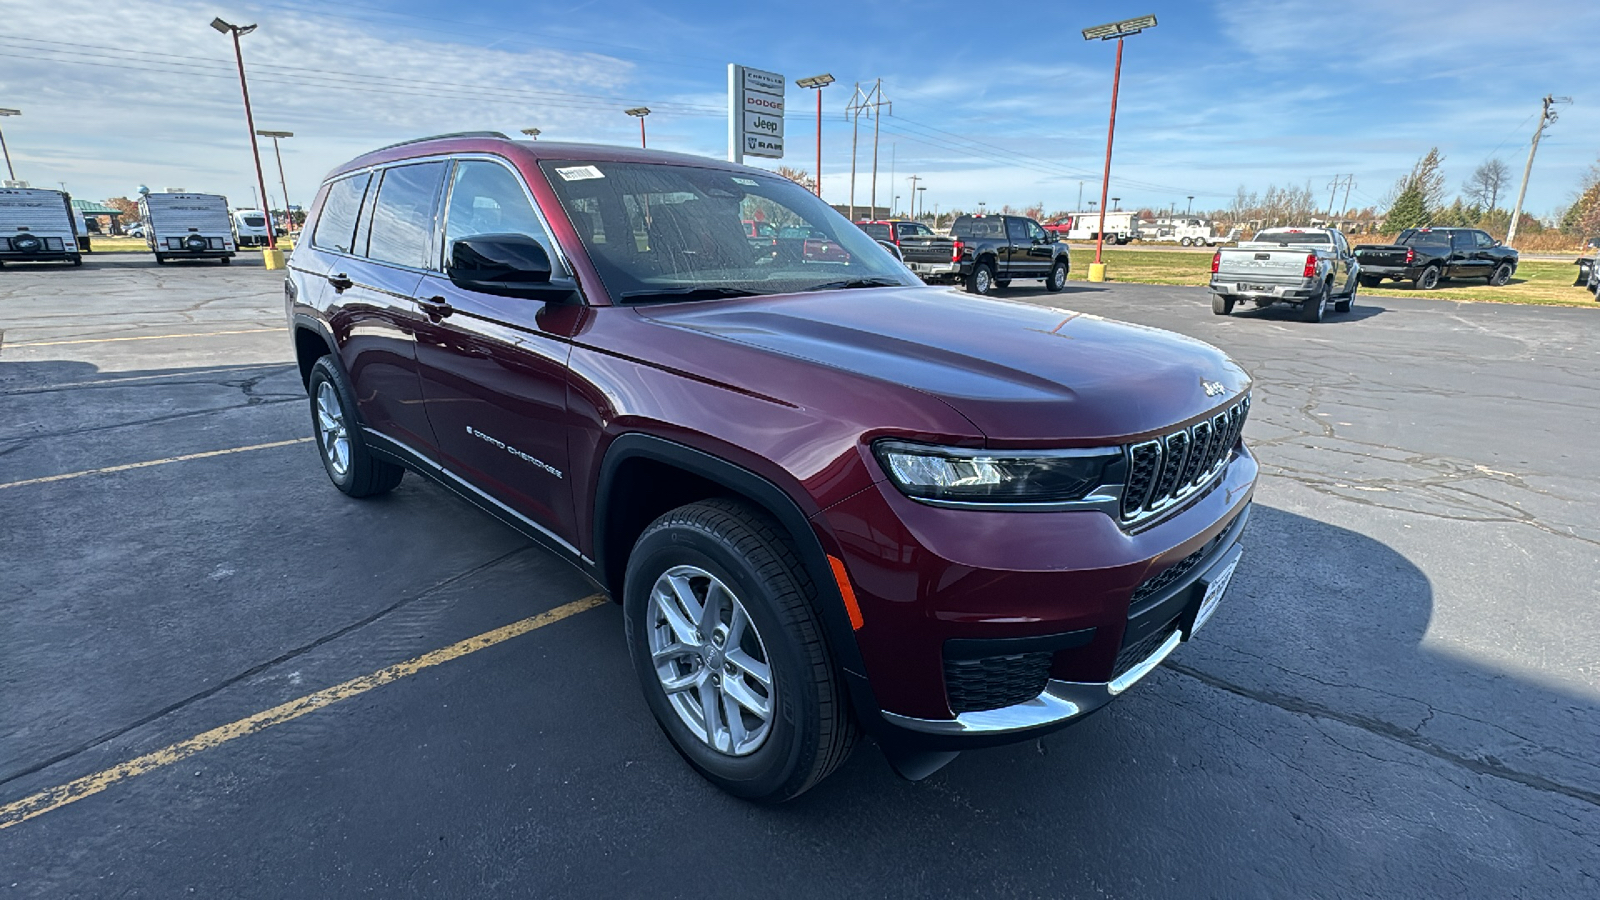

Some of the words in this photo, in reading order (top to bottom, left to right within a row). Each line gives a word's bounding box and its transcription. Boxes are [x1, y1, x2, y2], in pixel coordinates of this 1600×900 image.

[747, 73, 782, 84] CHRYSLER
[747, 98, 783, 110] DODGE
[753, 116, 777, 133] Jeep
[758, 141, 782, 151] RAM
[473, 429, 506, 449] GRAND
[506, 445, 563, 479] CHEROKEE
